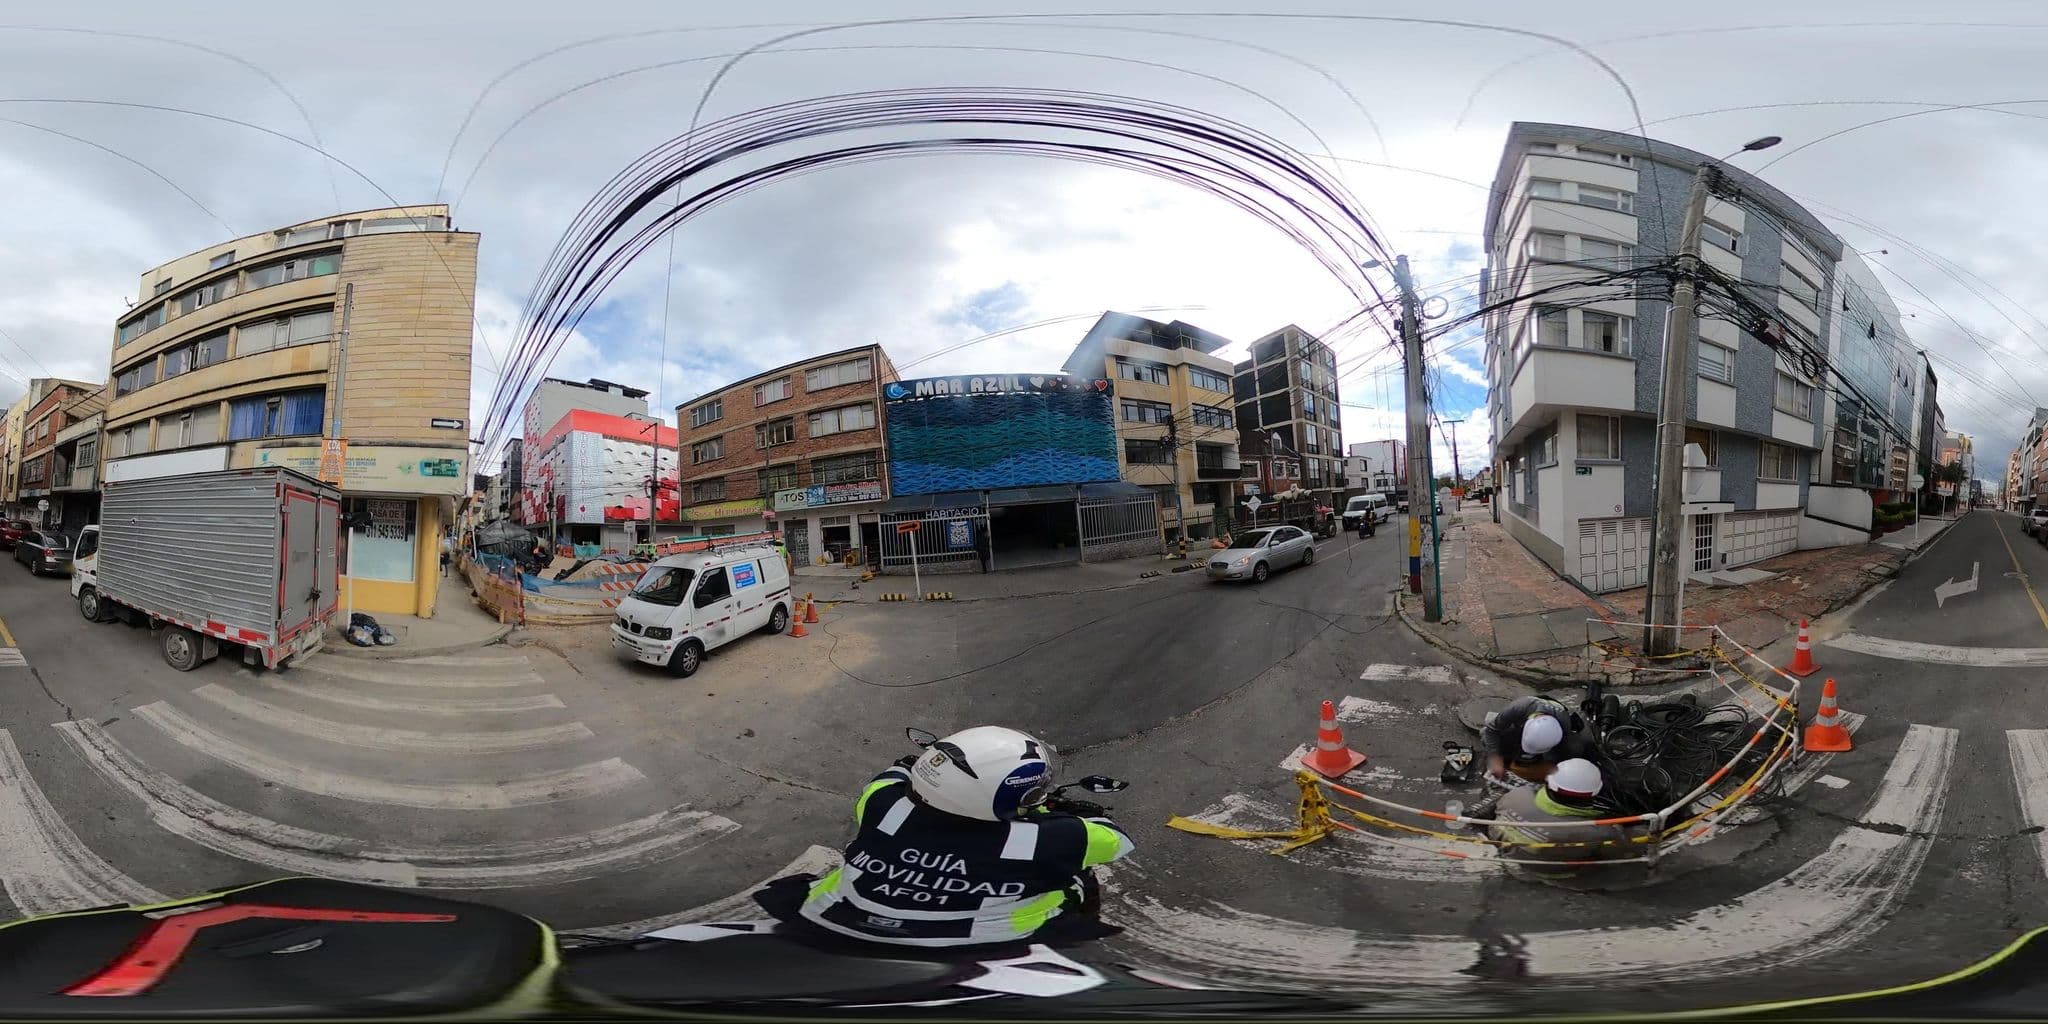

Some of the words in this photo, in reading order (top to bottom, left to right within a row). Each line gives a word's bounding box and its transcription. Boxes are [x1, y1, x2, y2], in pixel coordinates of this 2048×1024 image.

[915, 379, 963, 396] MAR
[970, 376, 1024, 392] AZUL
[850, 850, 1026, 896] MOVILIDAD
[900, 848, 968, 876] GUÍA
[872, 883, 949, 905] AF01
